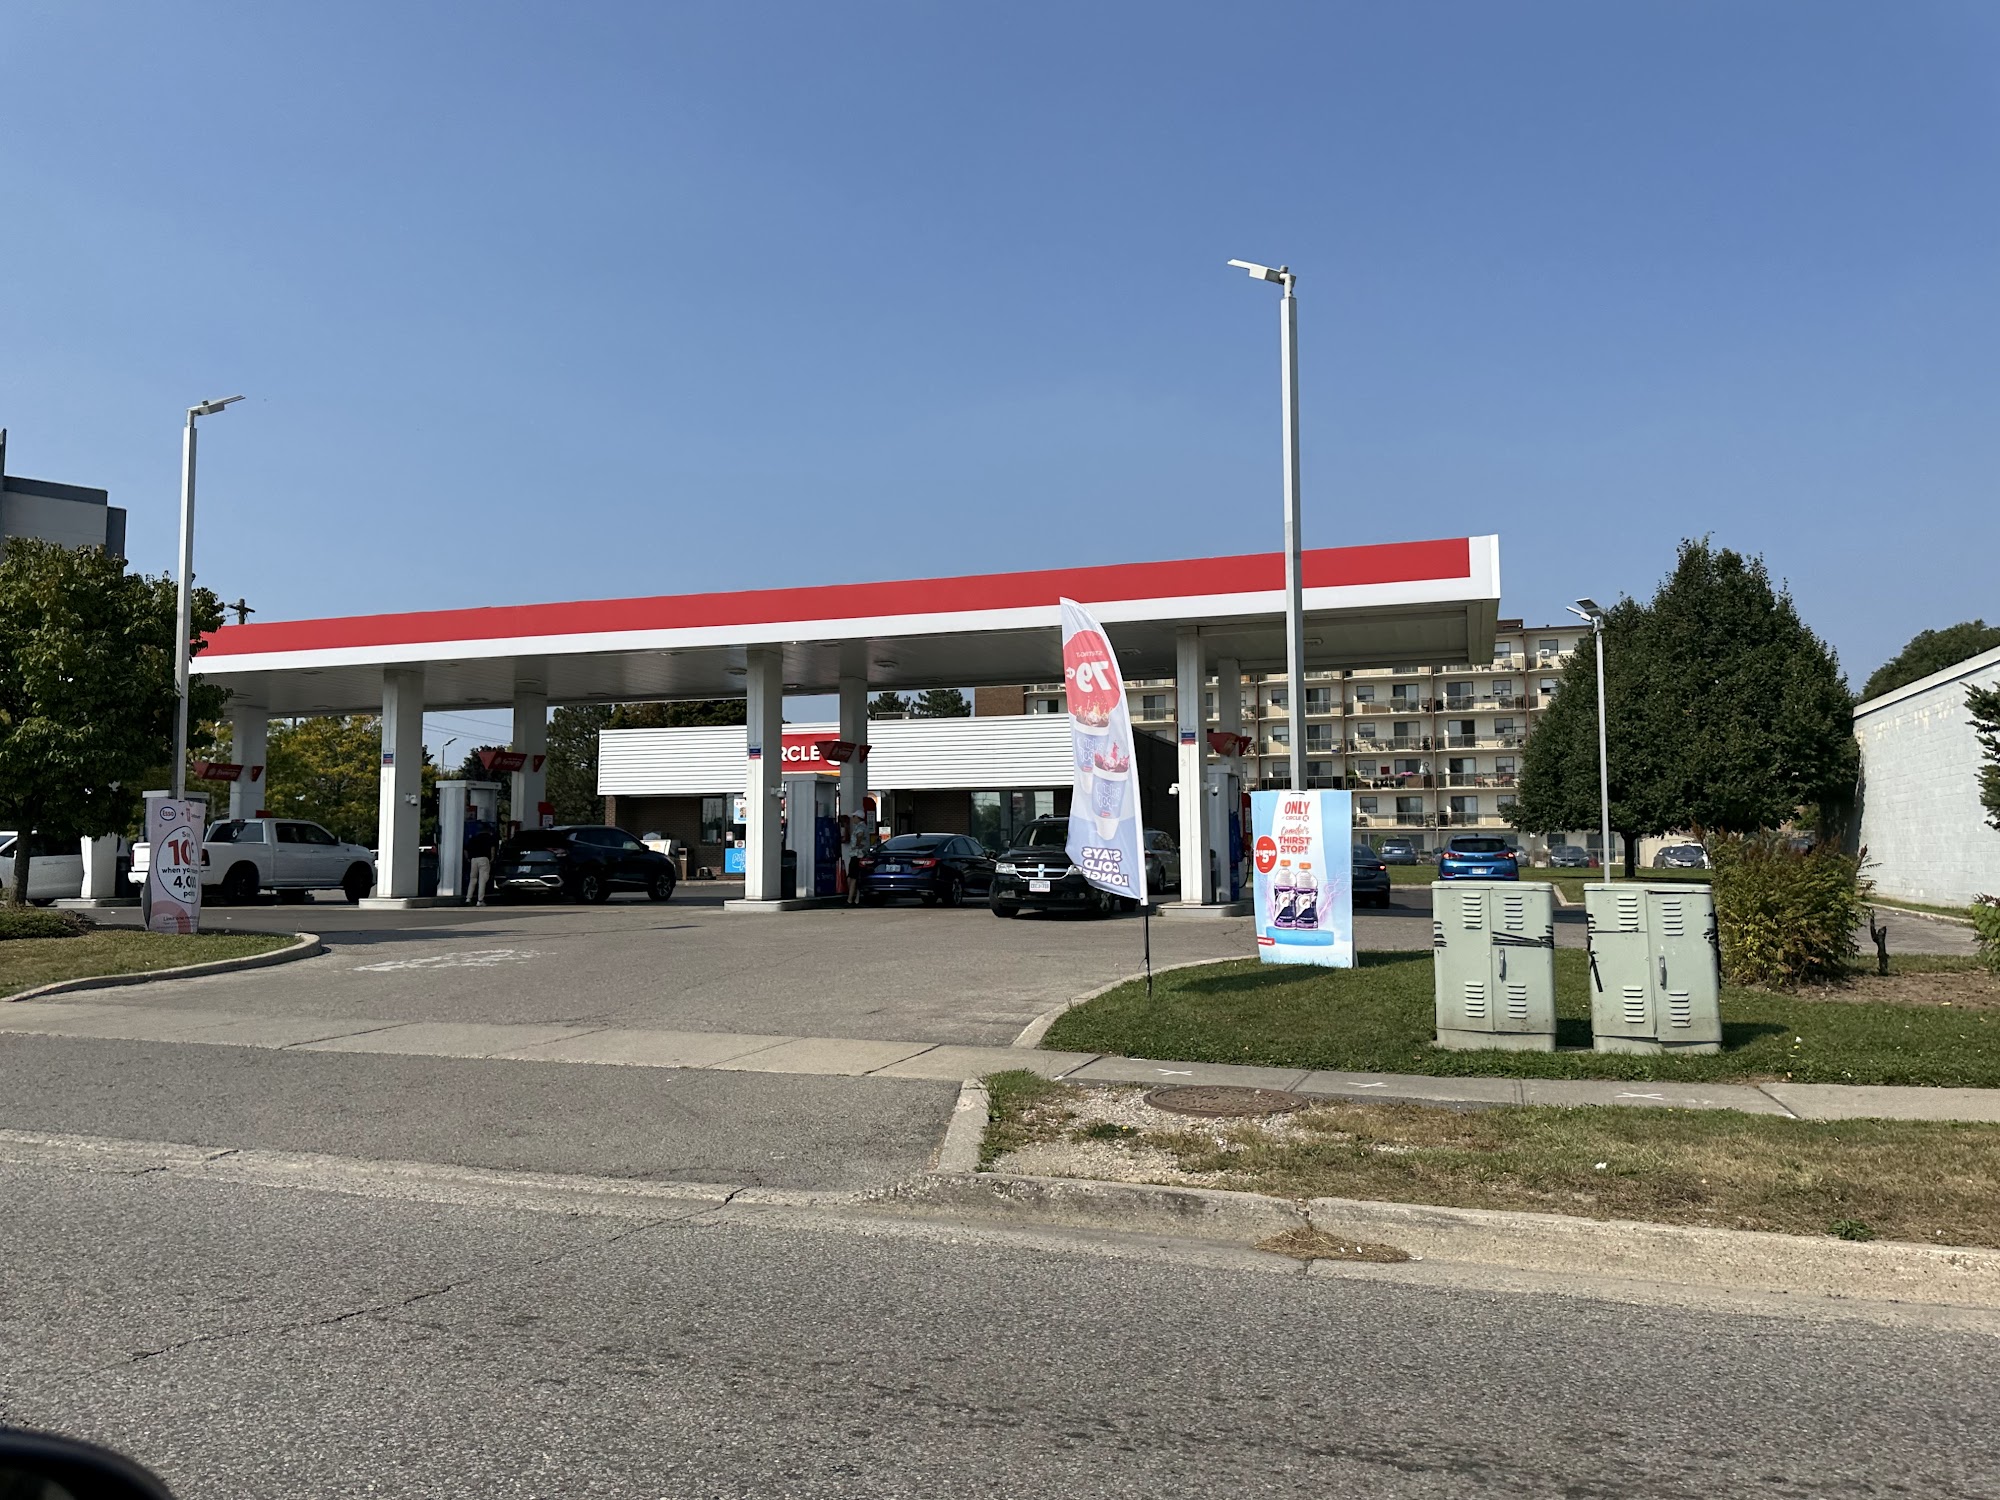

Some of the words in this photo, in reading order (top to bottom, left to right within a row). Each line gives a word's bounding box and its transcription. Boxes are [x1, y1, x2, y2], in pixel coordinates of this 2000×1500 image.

[1284, 801, 1311, 815] ONLY
[1278, 836, 1312, 846] THIRST
[1280, 845, 1309, 855] STOP!
